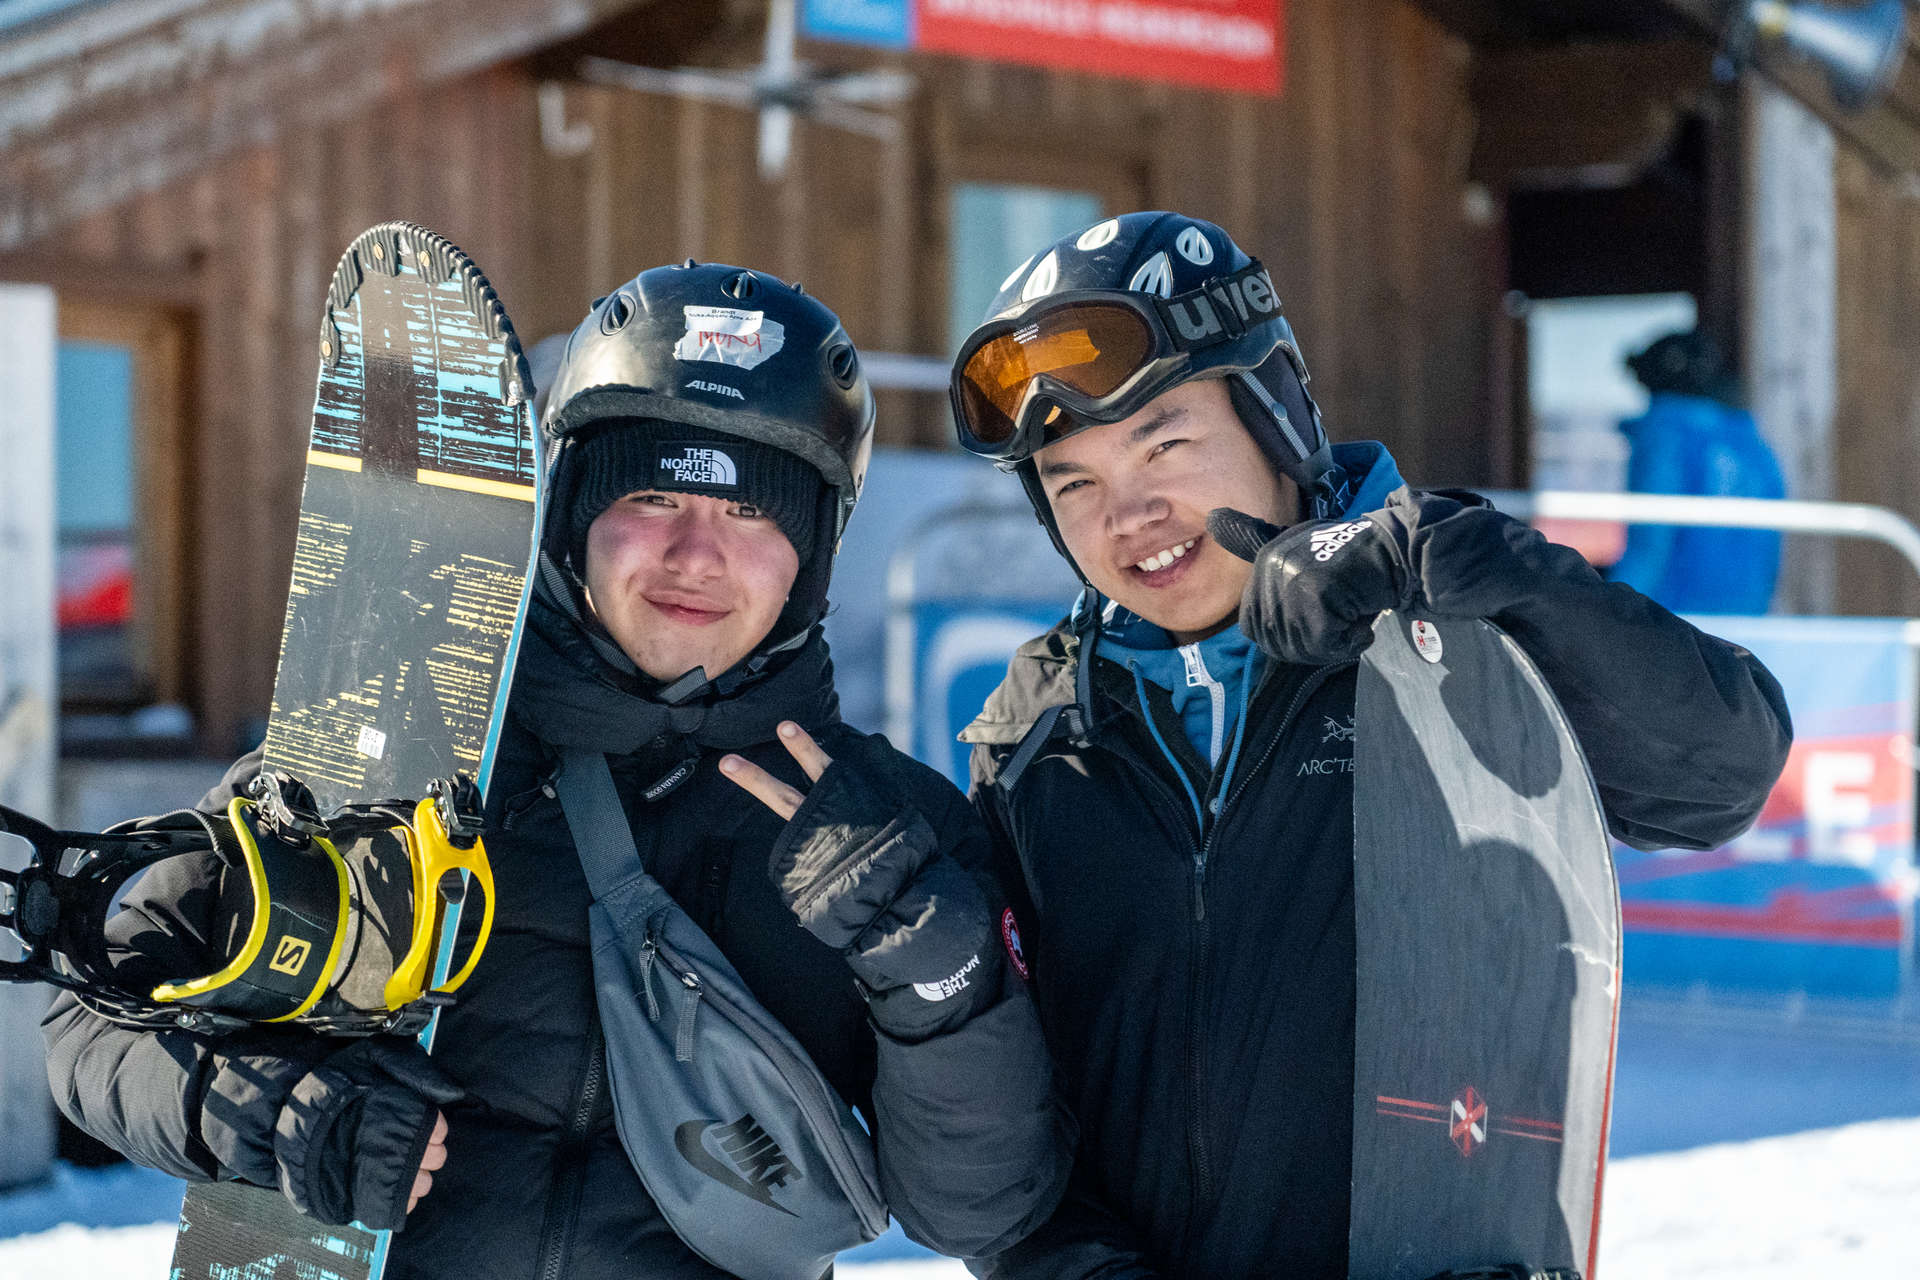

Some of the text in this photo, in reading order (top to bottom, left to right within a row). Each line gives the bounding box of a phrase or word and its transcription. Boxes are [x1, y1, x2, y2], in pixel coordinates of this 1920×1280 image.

[684, 380, 745, 401] ALPINA
[683, 447, 713, 460] THE
[660, 457, 712, 472] NORTH
[674, 469, 712, 483] FACE
[1314, 520, 1373, 562] adidas
[944, 976, 971, 998] THE
[709, 1112, 804, 1197] NIKE
